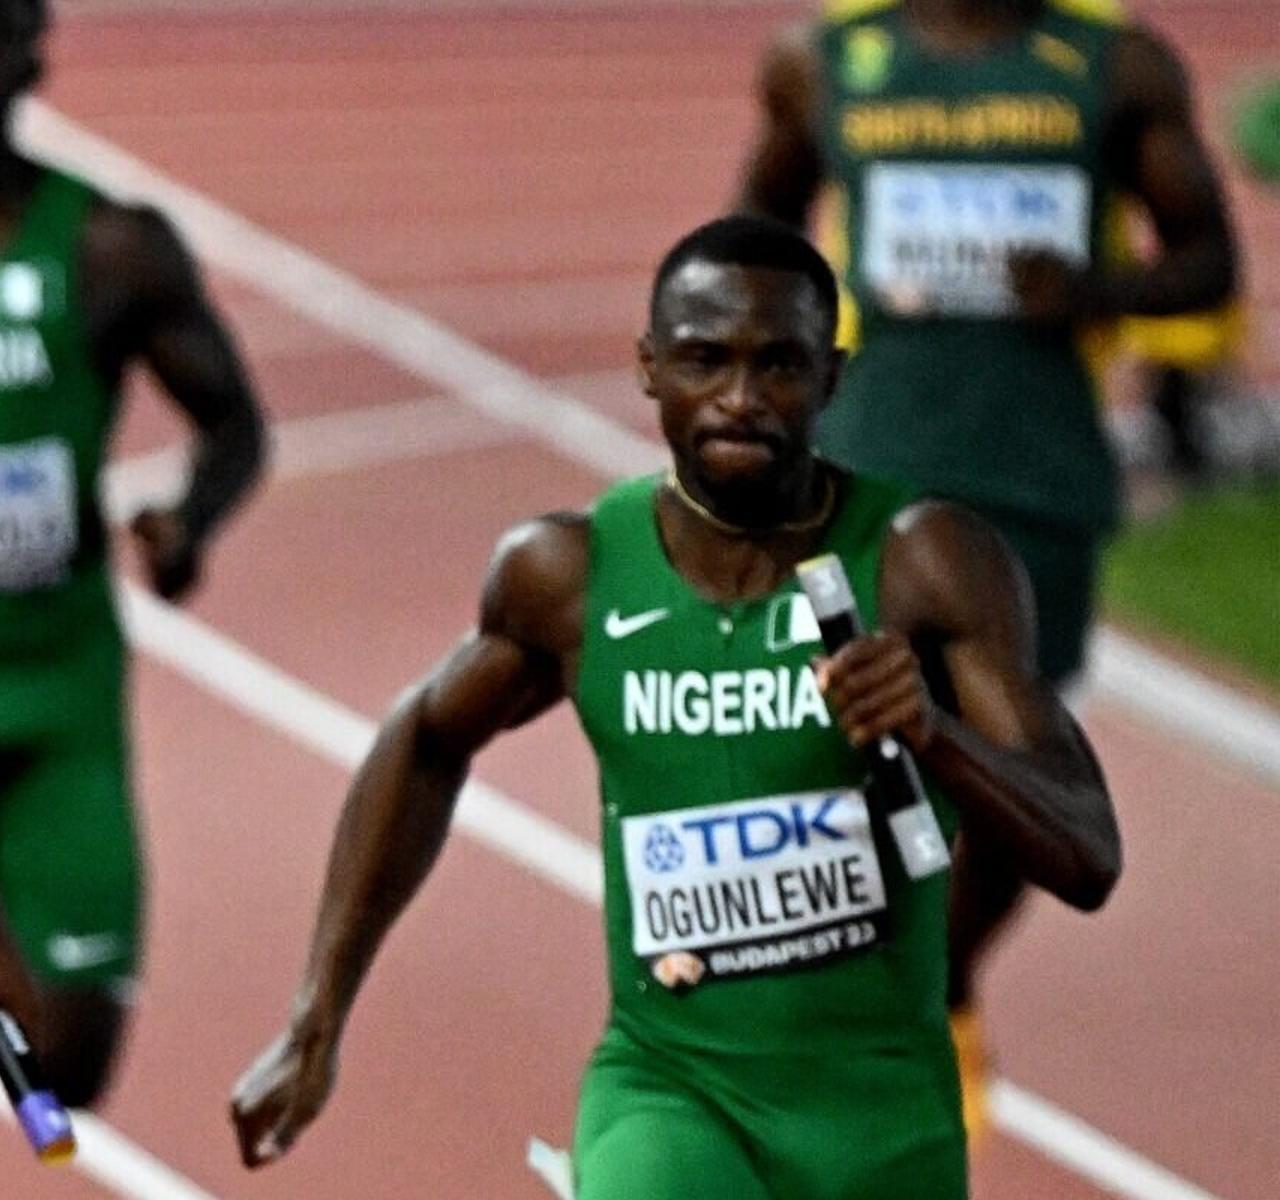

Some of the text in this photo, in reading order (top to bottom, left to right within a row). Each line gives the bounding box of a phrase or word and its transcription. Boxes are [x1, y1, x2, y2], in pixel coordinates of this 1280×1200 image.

[622, 667, 831, 735] NIGERIA
[682, 795, 848, 865] TDK
[644, 854, 874, 942] OGUNLEWE
